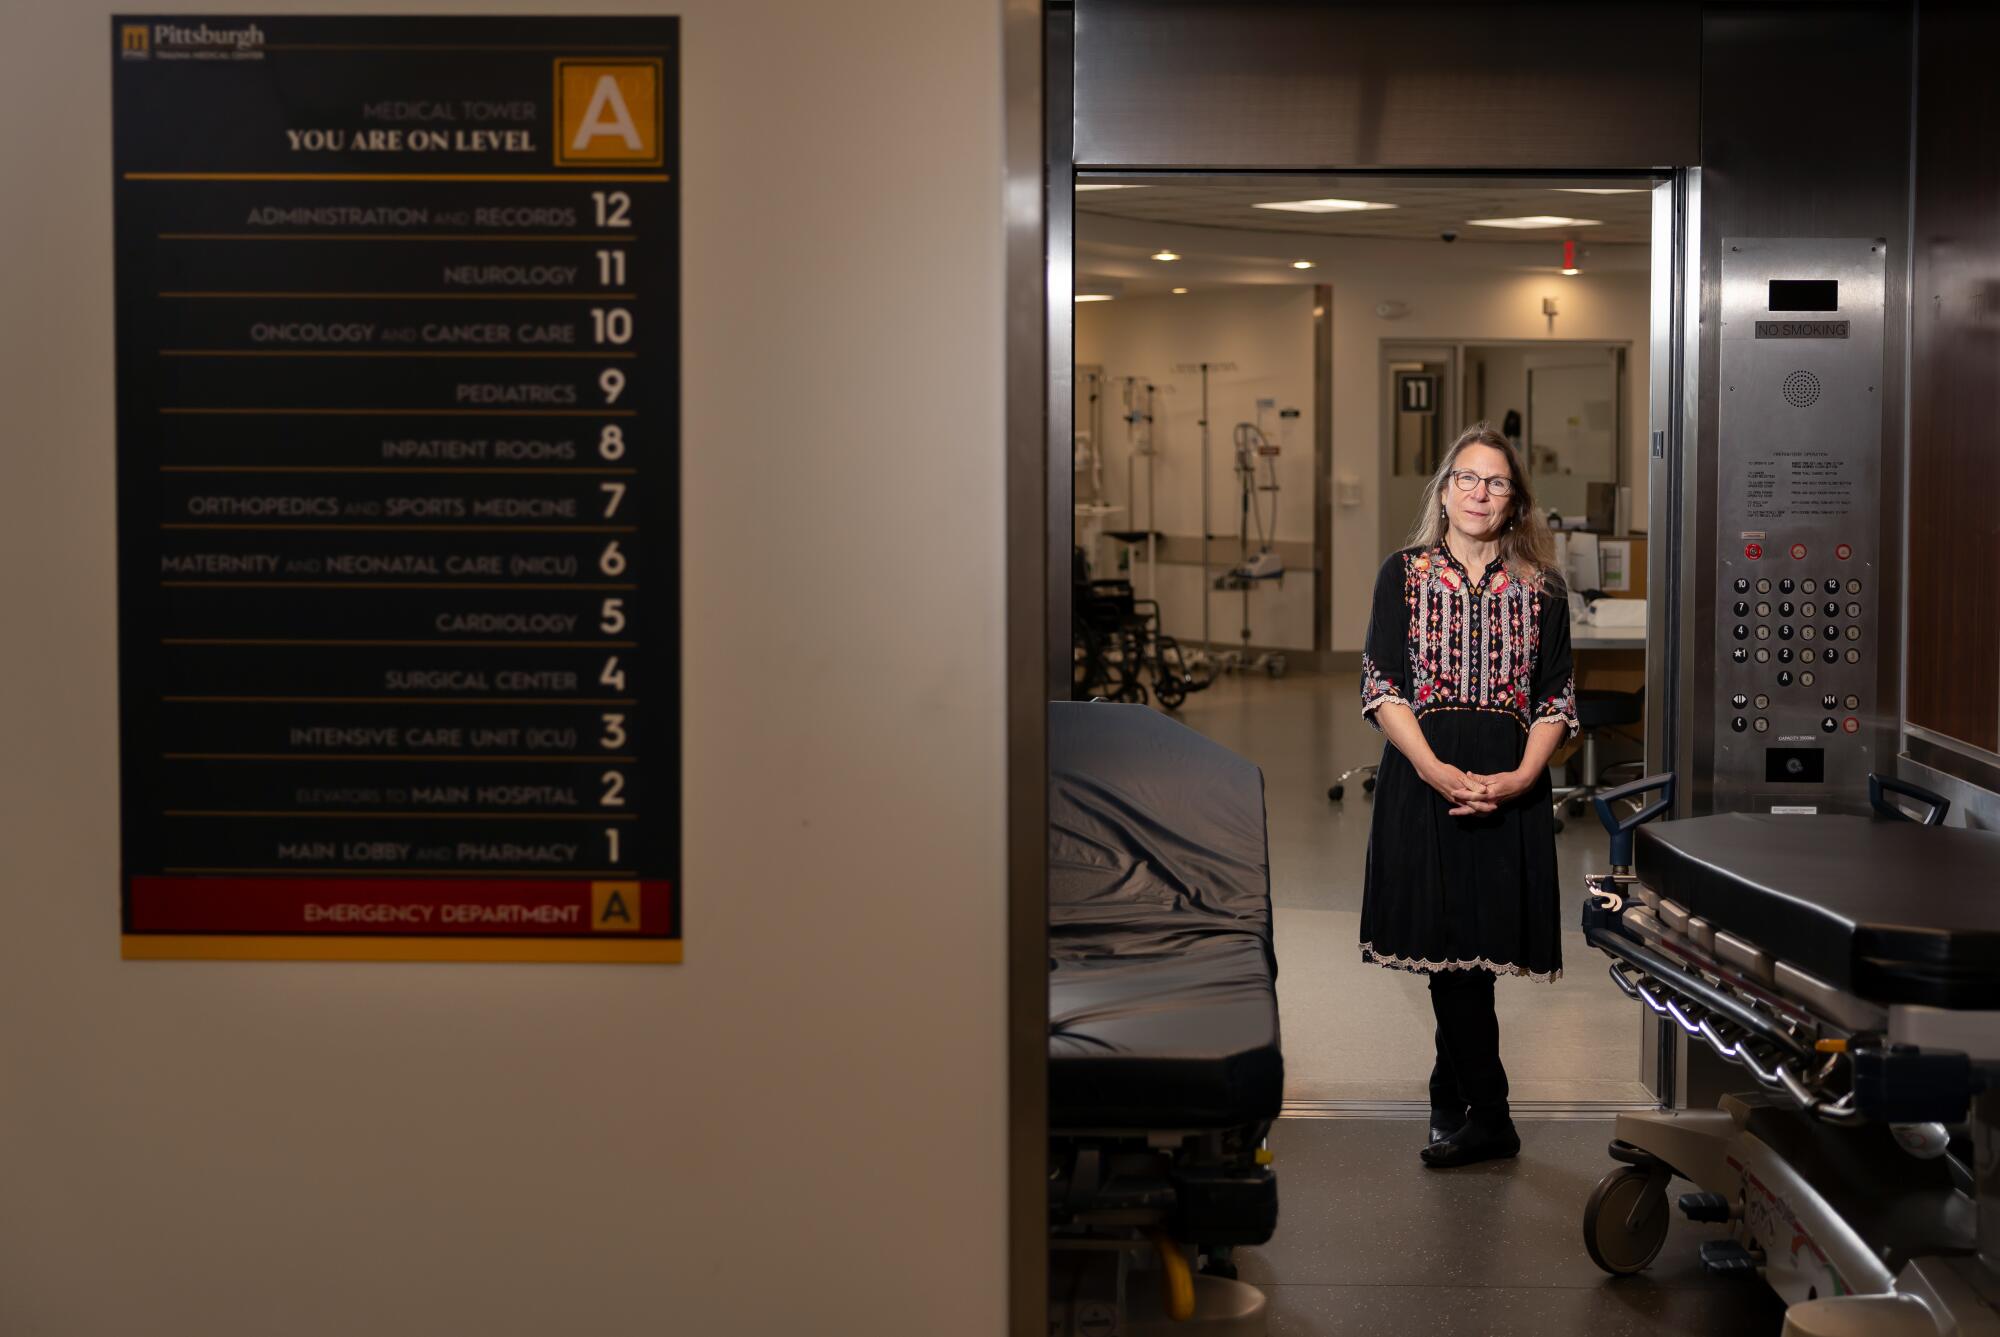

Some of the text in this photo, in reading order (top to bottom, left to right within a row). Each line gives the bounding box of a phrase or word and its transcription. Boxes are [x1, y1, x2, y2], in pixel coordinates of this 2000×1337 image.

[154, 23, 265, 51] Pittsburgh
[363, 102, 536, 121] MEDICAL TOWER
[572, 74, 643, 151] A
[287, 129, 535, 152] YOU ARE ON LEVEL
[246, 191, 631, 227] ADMINISTRATION AND RECORDS 12
[443, 250, 625, 286] NEUROLOGY 11
[250, 308, 633, 344] ONCOLOGY AND CANCER CARE 10
[1758, 324, 1846, 336] NO SMOKING
[456, 368, 625, 404] PEDIATRICS 9
[1407, 380, 1427, 408] 11
[382, 424, 625, 460] INPATIENT ROOMS 8
[187, 482, 626, 518] ORTHOPEDICS AND SPORTS MEDICINE 7
[161, 541, 626, 577] MATERNITY AND NEONATAL CARE (NICU) 6
[1738, 580, 1746, 588] 10
[1784, 580, 1791, 588] 11
[1828, 580, 1836, 588] 12
[435, 598, 625, 634] CARDIOLOGY 5
[1739, 602, 1745, 611] 7
[1783, 603, 1789, 611] 8
[1829, 603, 1834, 612] 9
[1738, 626, 1743, 634] 4
[1783, 626, 1789, 634] 5
[1828, 626, 1833, 635] 6
[1783, 649, 1788, 657] 2
[1828, 649, 1834, 657] 3
[385, 656, 625, 691] SURGICAL CENTER 4
[1782, 673, 1788, 681] A
[290, 713, 626, 749] INTENSIVE CARE UNIT (ICU) 3
[295, 770, 625, 806] ELEVATORS TO MAIN HOSPITAL 2
[278, 828, 619, 863] MAIN LOBBY AND PHARMACY 1
[303, 890, 632, 924] EMERGENCY DEPARTMENT A
